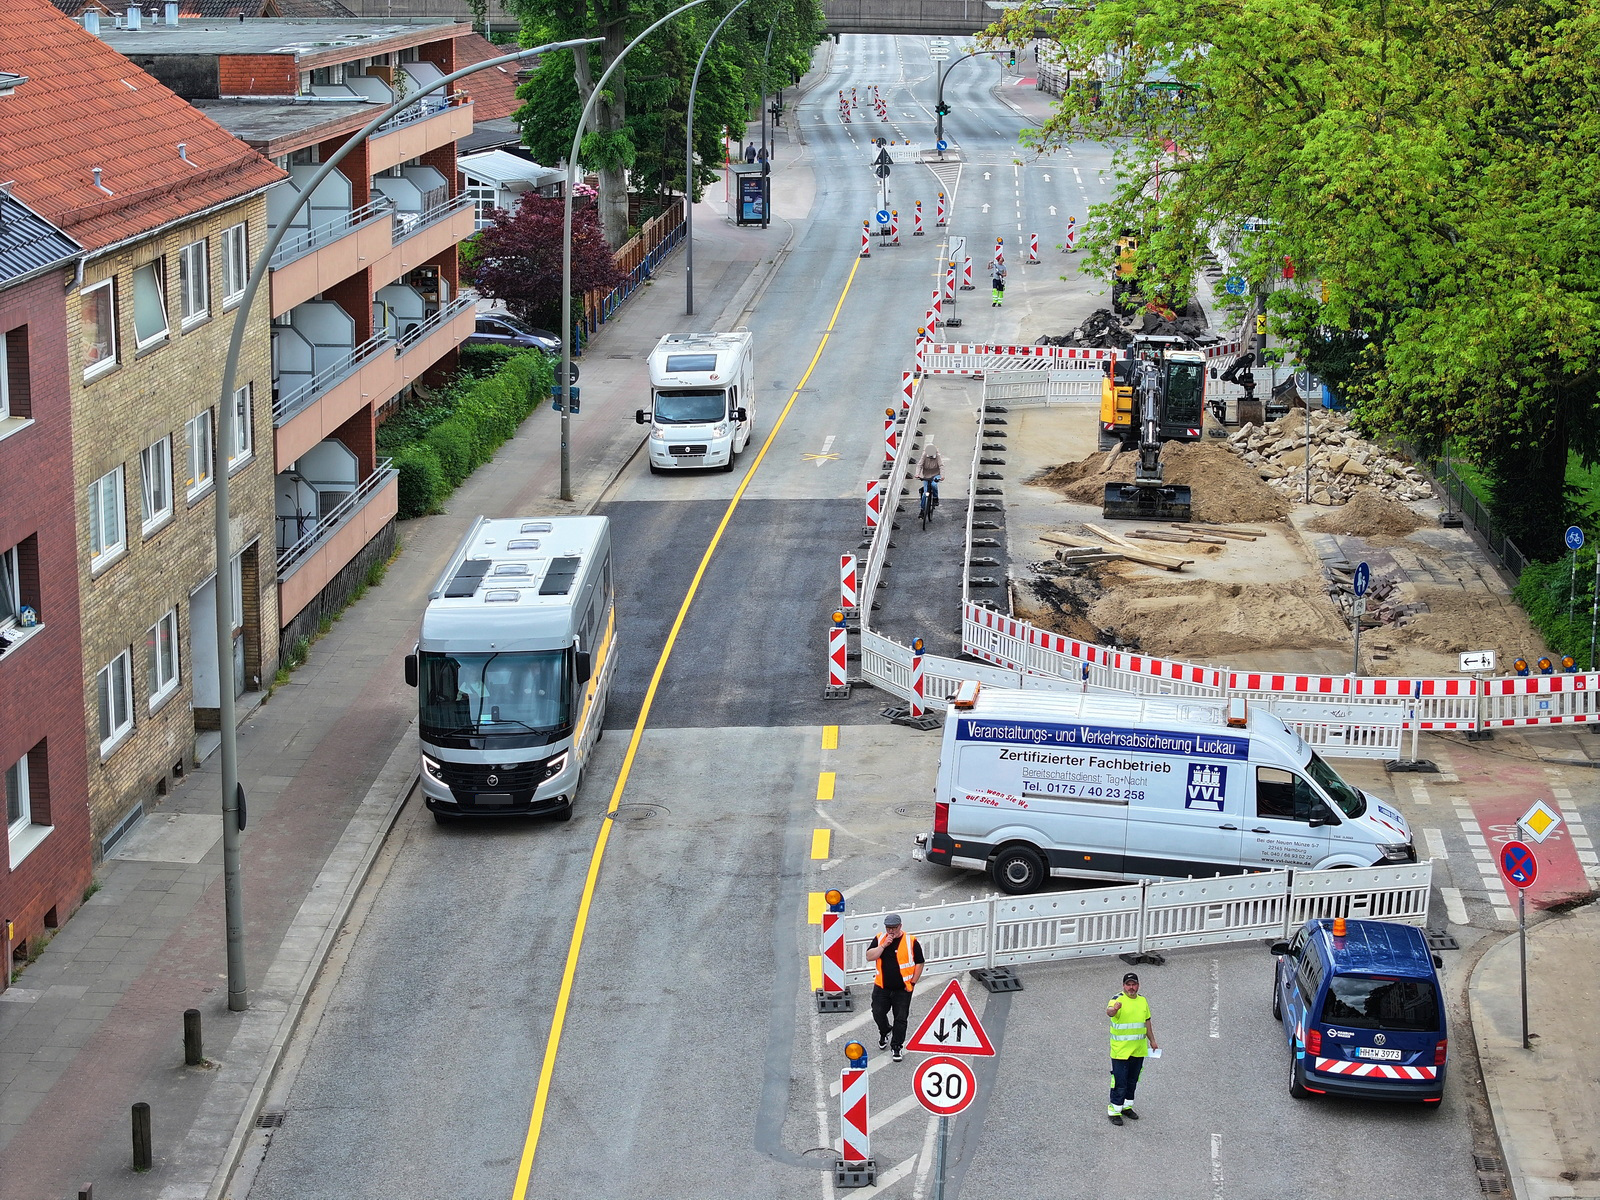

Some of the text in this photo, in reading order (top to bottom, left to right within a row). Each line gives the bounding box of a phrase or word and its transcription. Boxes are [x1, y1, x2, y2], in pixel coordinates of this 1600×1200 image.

[967, 721, 1236, 755] Veranstaltungs- und Verkehrsabsicherung Luckau
[999, 748, 1171, 773] Zertifizierter Fachbetrieb
[1022, 767, 1148, 787] Bereitschaftsdienst: Tag+Nacht
[965, 794, 980, 802] auf
[986, 788, 1005, 798] wenn
[1005, 794, 1017, 803] Sie
[1022, 780, 1145, 800] Tel. 0175 / 40 23 258
[1188, 784, 1223, 801] VVL
[1283, 846, 1307, 854] Hamburg
[1381, 1050, 1400, 1058] 3973
[926, 1071, 962, 1100] 30
